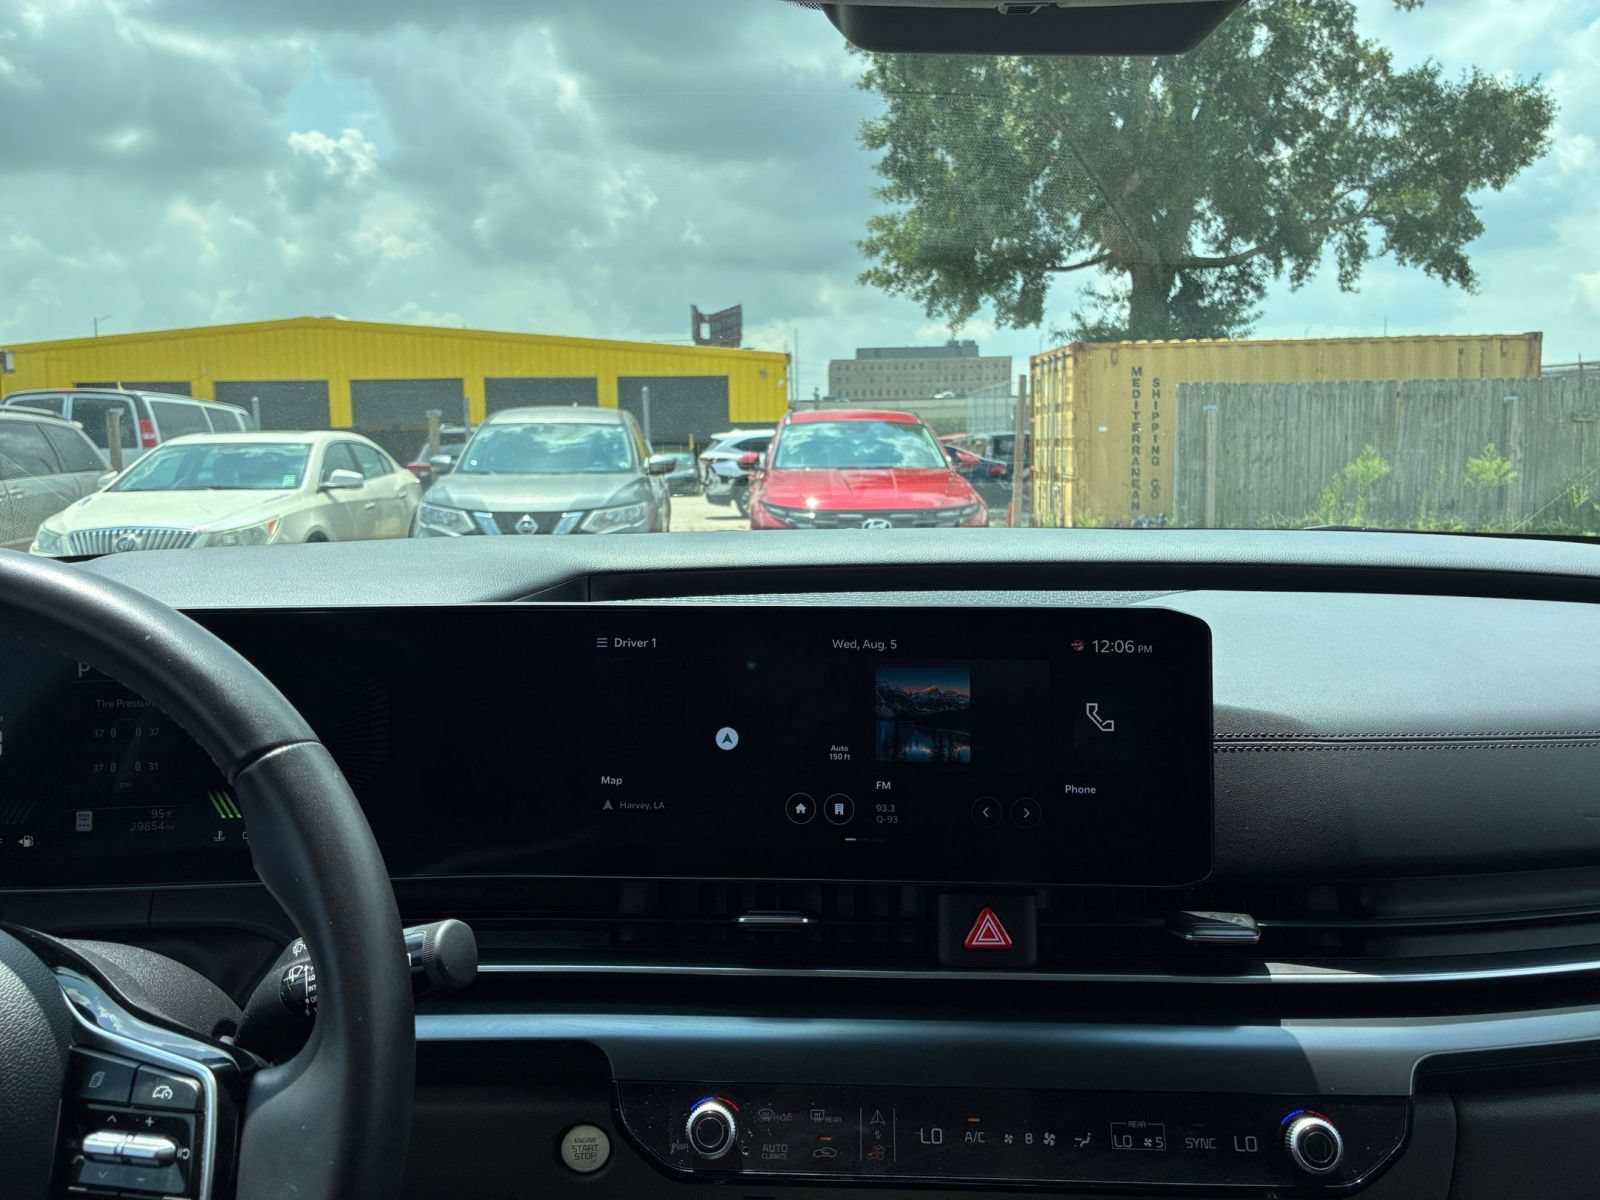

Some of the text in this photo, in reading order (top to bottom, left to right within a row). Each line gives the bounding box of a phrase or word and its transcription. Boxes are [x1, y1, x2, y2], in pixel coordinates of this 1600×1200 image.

[1131, 366, 1143, 511] MEDITERRANEAN
[1150, 377, 1161, 500] SHIPPING CO
[614, 637, 657, 648] Driver 1
[831, 639, 897, 652] Wed, Aug. 5
[1092, 639, 1153, 653] 12:06 PM
[77, 661, 91, 678] P
[96, 699, 153, 709] Tire Pressur
[148, 727, 160, 736] 37
[830, 744, 849, 752] Auto
[829, 753, 851, 761] 150 ft
[600, 775, 623, 787] Map
[875, 780, 891, 790] FM
[1064, 784, 1097, 794] Phone
[619, 800, 665, 811] Harvey, LA
[875, 804, 896, 813] 93.3
[875, 815, 899, 824] Q-93
[1127, 1120, 1147, 1129] REAR
[920, 1127, 1034, 1145] LO A/C 8
[1113, 1134, 1164, 1149] LO 5
[1185, 1137, 1217, 1149] SYNC
[1233, 1135, 1258, 1153] LO
[571, 1143, 600, 1153] START
[761, 1143, 789, 1153] AUTO
[574, 1152, 597, 1161] STOP
[761, 1153, 789, 1161] CLIMATE
